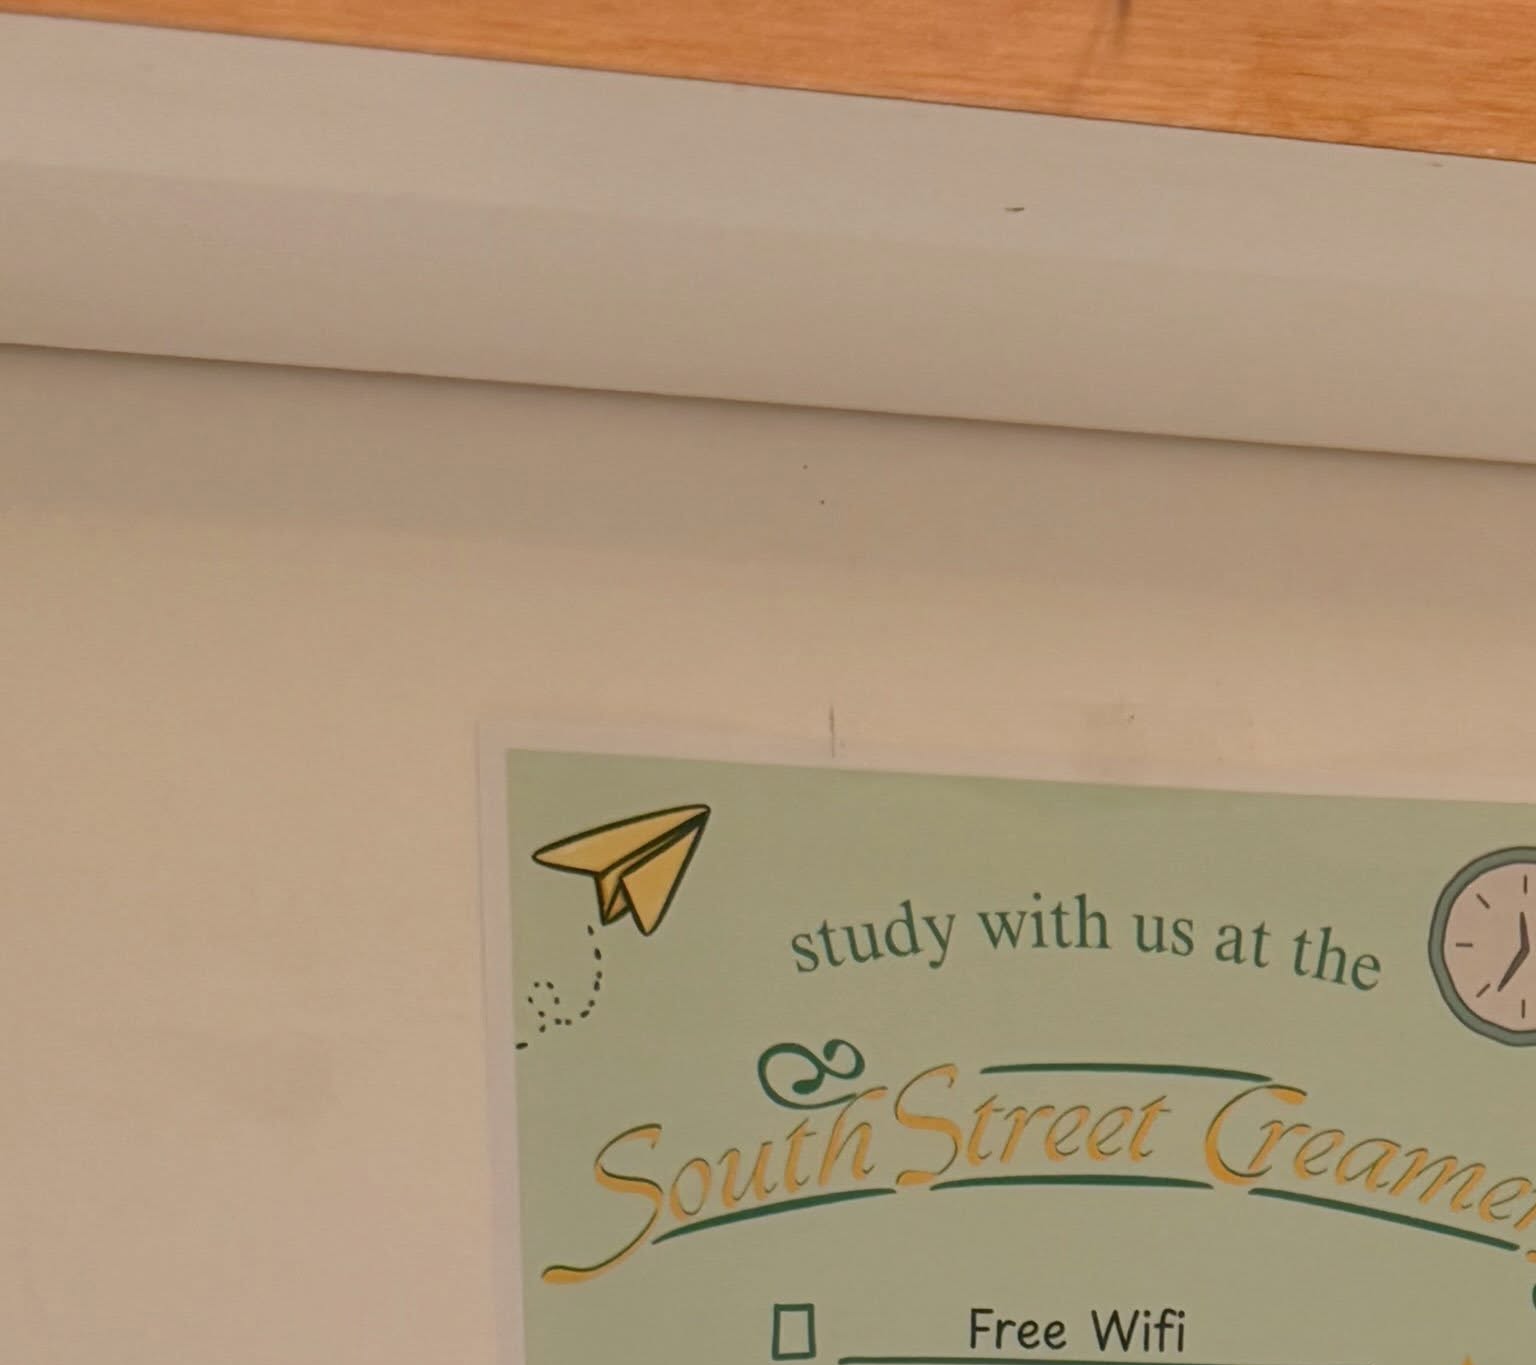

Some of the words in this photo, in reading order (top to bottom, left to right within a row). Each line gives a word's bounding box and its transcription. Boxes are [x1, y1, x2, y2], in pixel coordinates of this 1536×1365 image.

[791, 899, 956, 973] study
[977, 892, 1110, 951] with
[1133, 912, 1194, 957] us
[1215, 921, 1271, 968] at
[1292, 926, 1382, 992] the
[541, 1085, 888, 1285] South
[894, 1063, 1172, 1187] Street
[969, 1307, 1067, 1350] Free
[1090, 1308, 1187, 1353] Wifi
